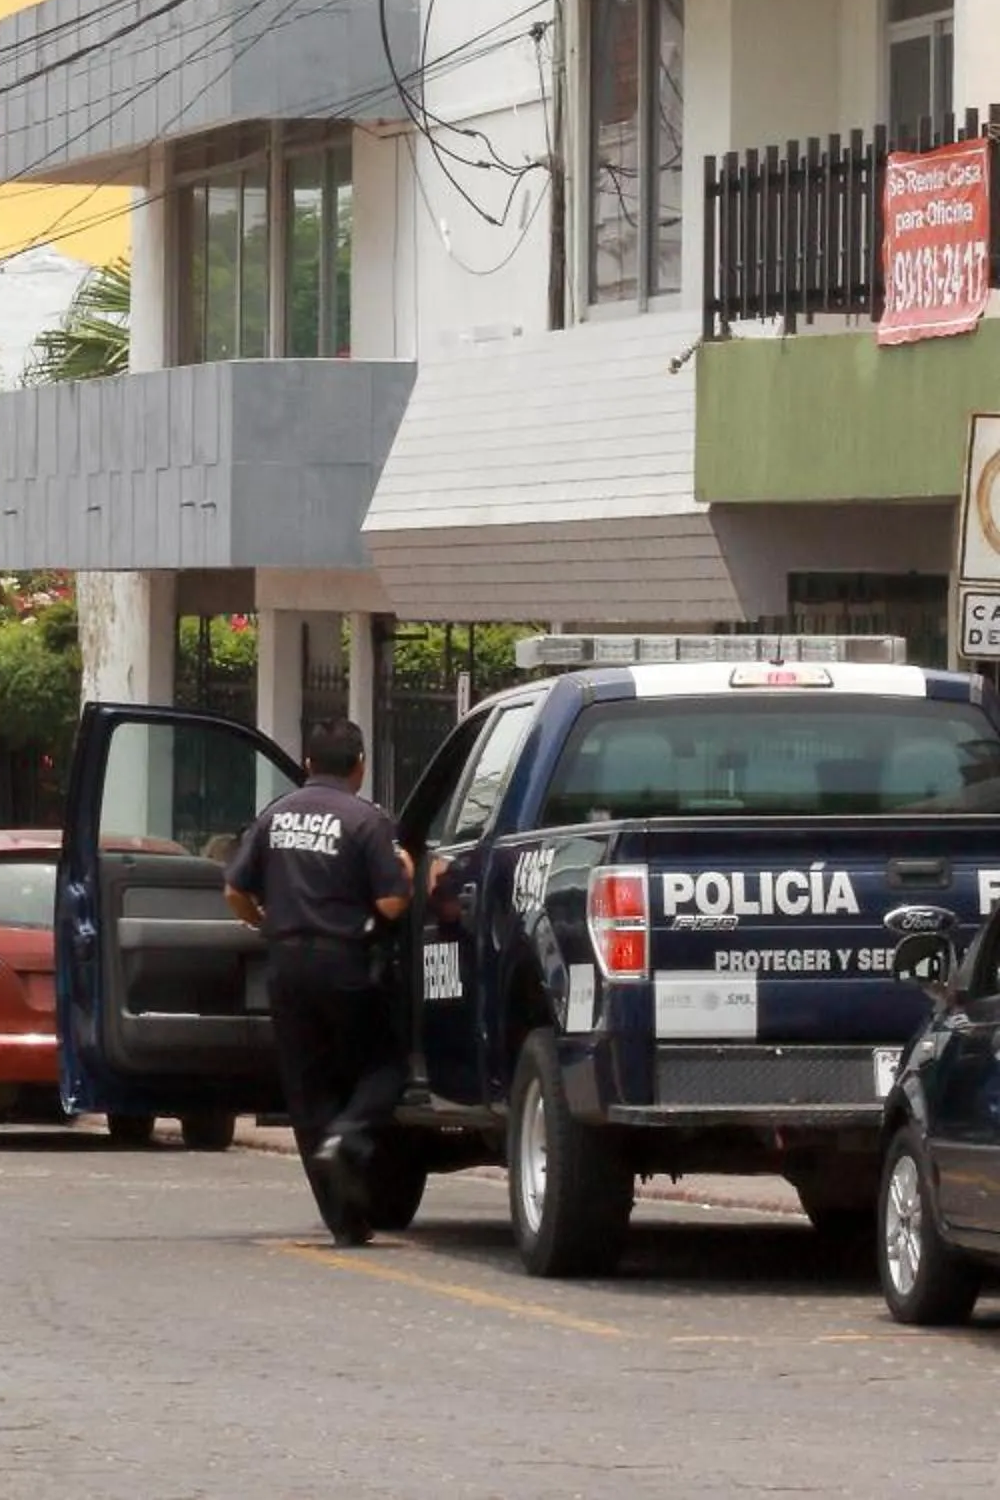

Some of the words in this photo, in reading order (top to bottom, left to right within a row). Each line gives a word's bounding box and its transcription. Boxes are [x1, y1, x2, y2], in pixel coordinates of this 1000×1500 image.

[947, 162, 982, 188] Casa
[895, 209, 924, 238] para
[926, 198, 974, 228] Oficina
[269, 830, 340, 855] FEDERAL
[662, 862, 860, 916] POLICÍA
[715, 949, 832, 972] PROTEGER
[838, 949, 852, 971] Y
